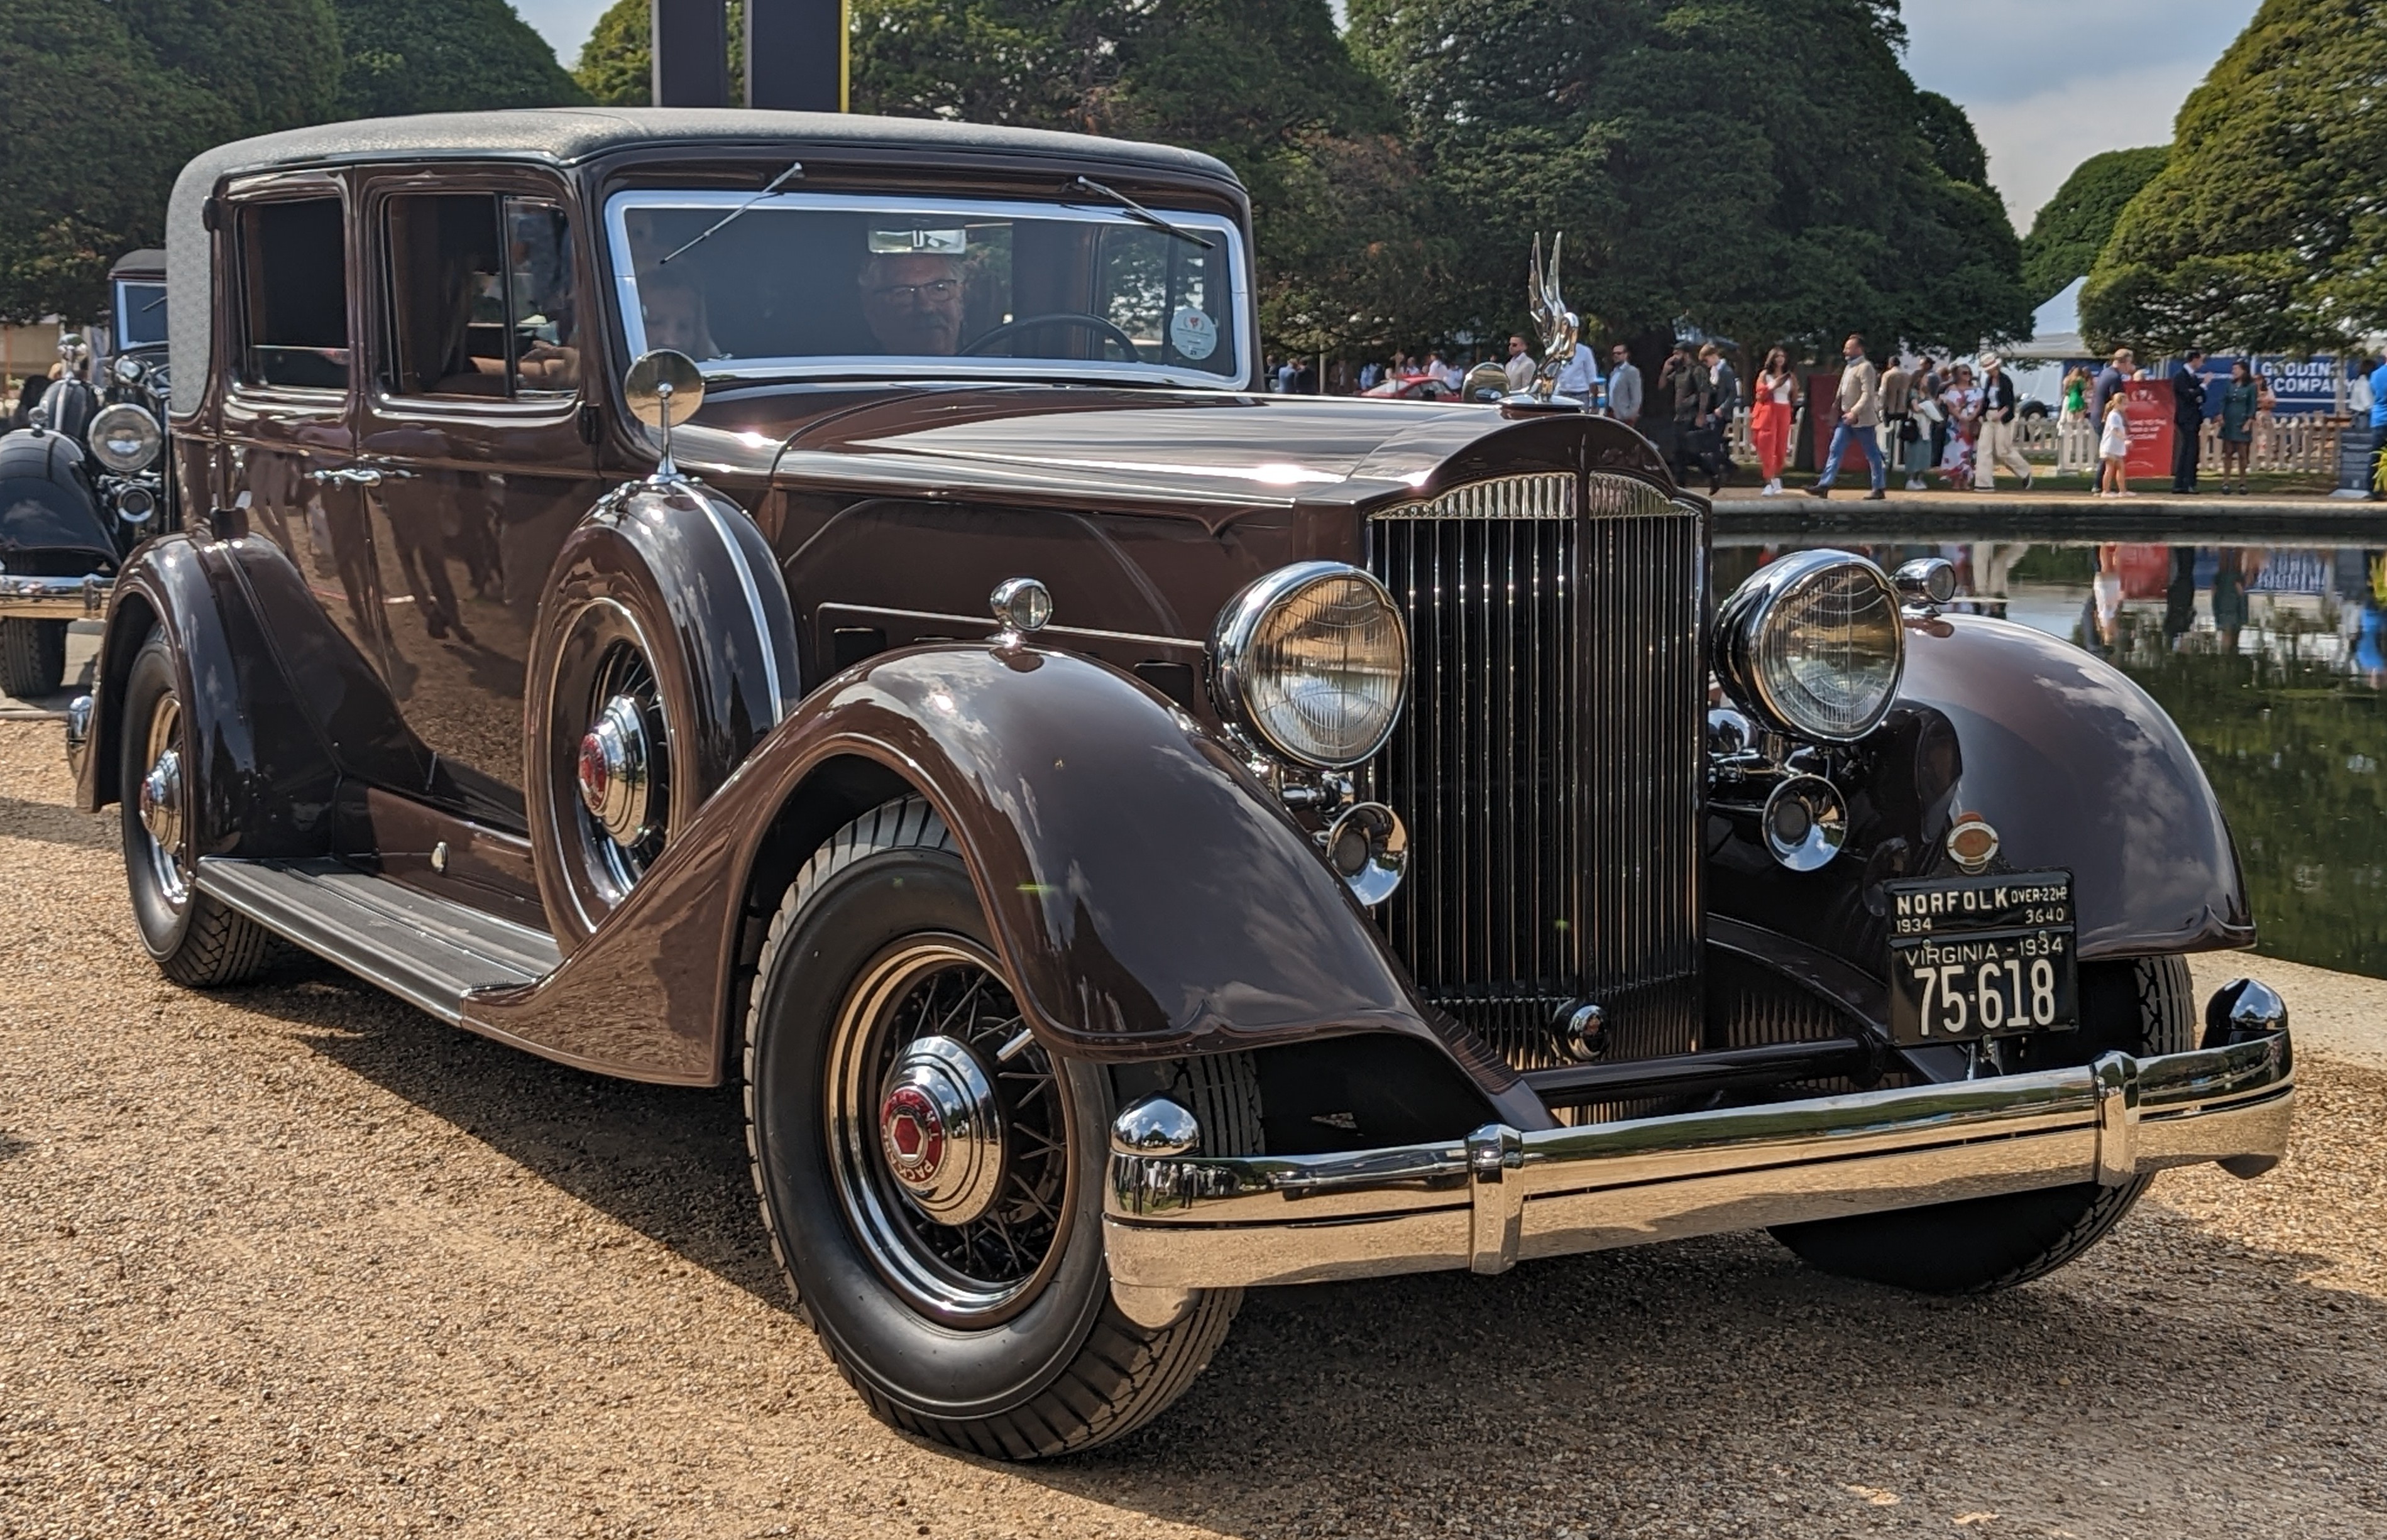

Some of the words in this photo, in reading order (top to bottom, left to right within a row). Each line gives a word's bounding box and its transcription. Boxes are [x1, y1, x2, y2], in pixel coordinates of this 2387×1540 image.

[1897, 887, 2008, 915] NORFOLK
[1896, 917, 1931, 933] 1934
[2025, 907, 2064, 924] 3640
